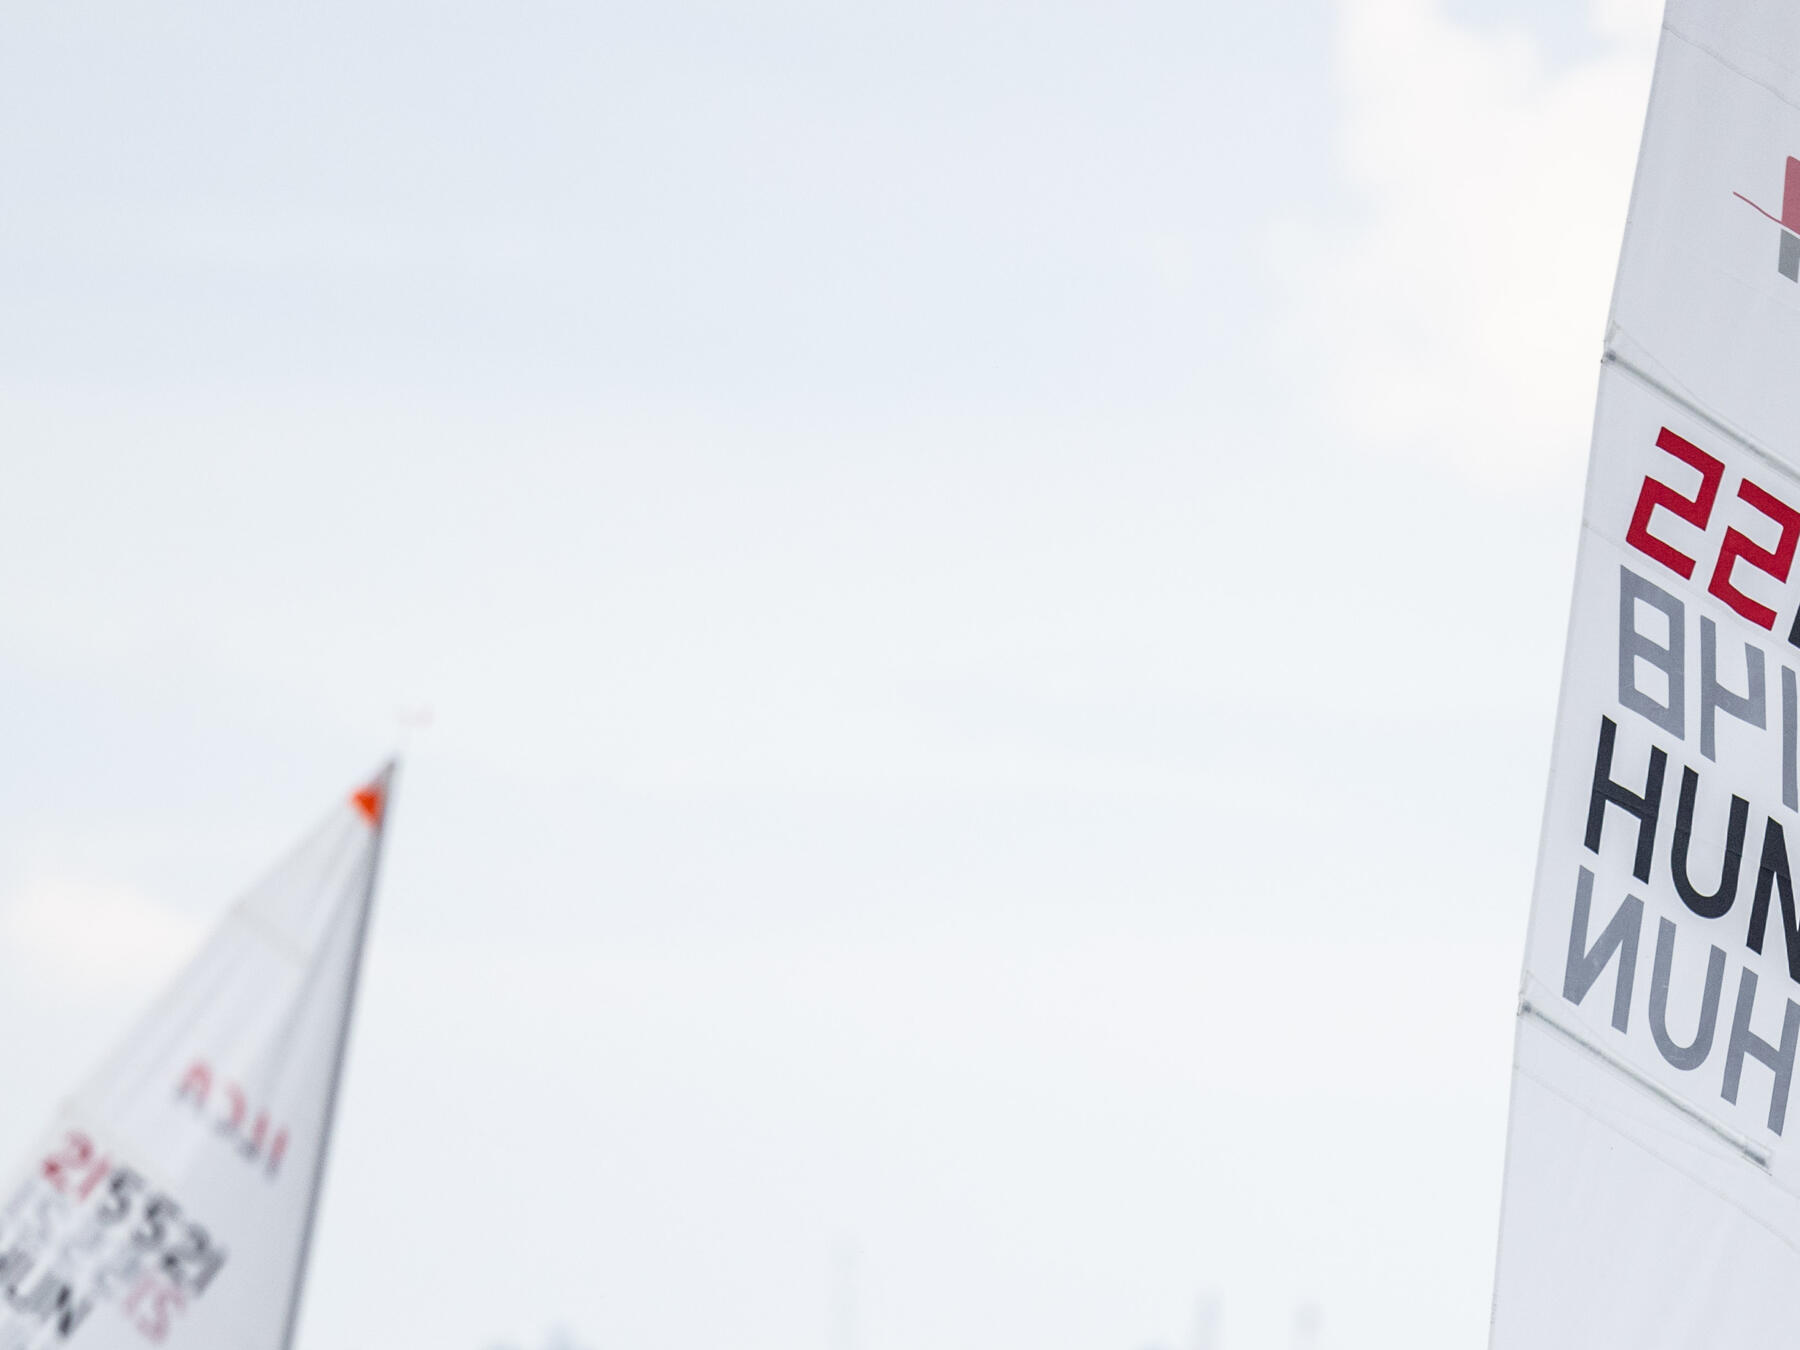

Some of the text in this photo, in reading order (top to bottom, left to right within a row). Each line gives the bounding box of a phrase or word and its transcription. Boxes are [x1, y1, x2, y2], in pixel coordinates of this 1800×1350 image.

[1626, 426, 1800, 650] 22
[1584, 714, 1800, 985] HUN
[41, 1131, 228, 1294] 215521
